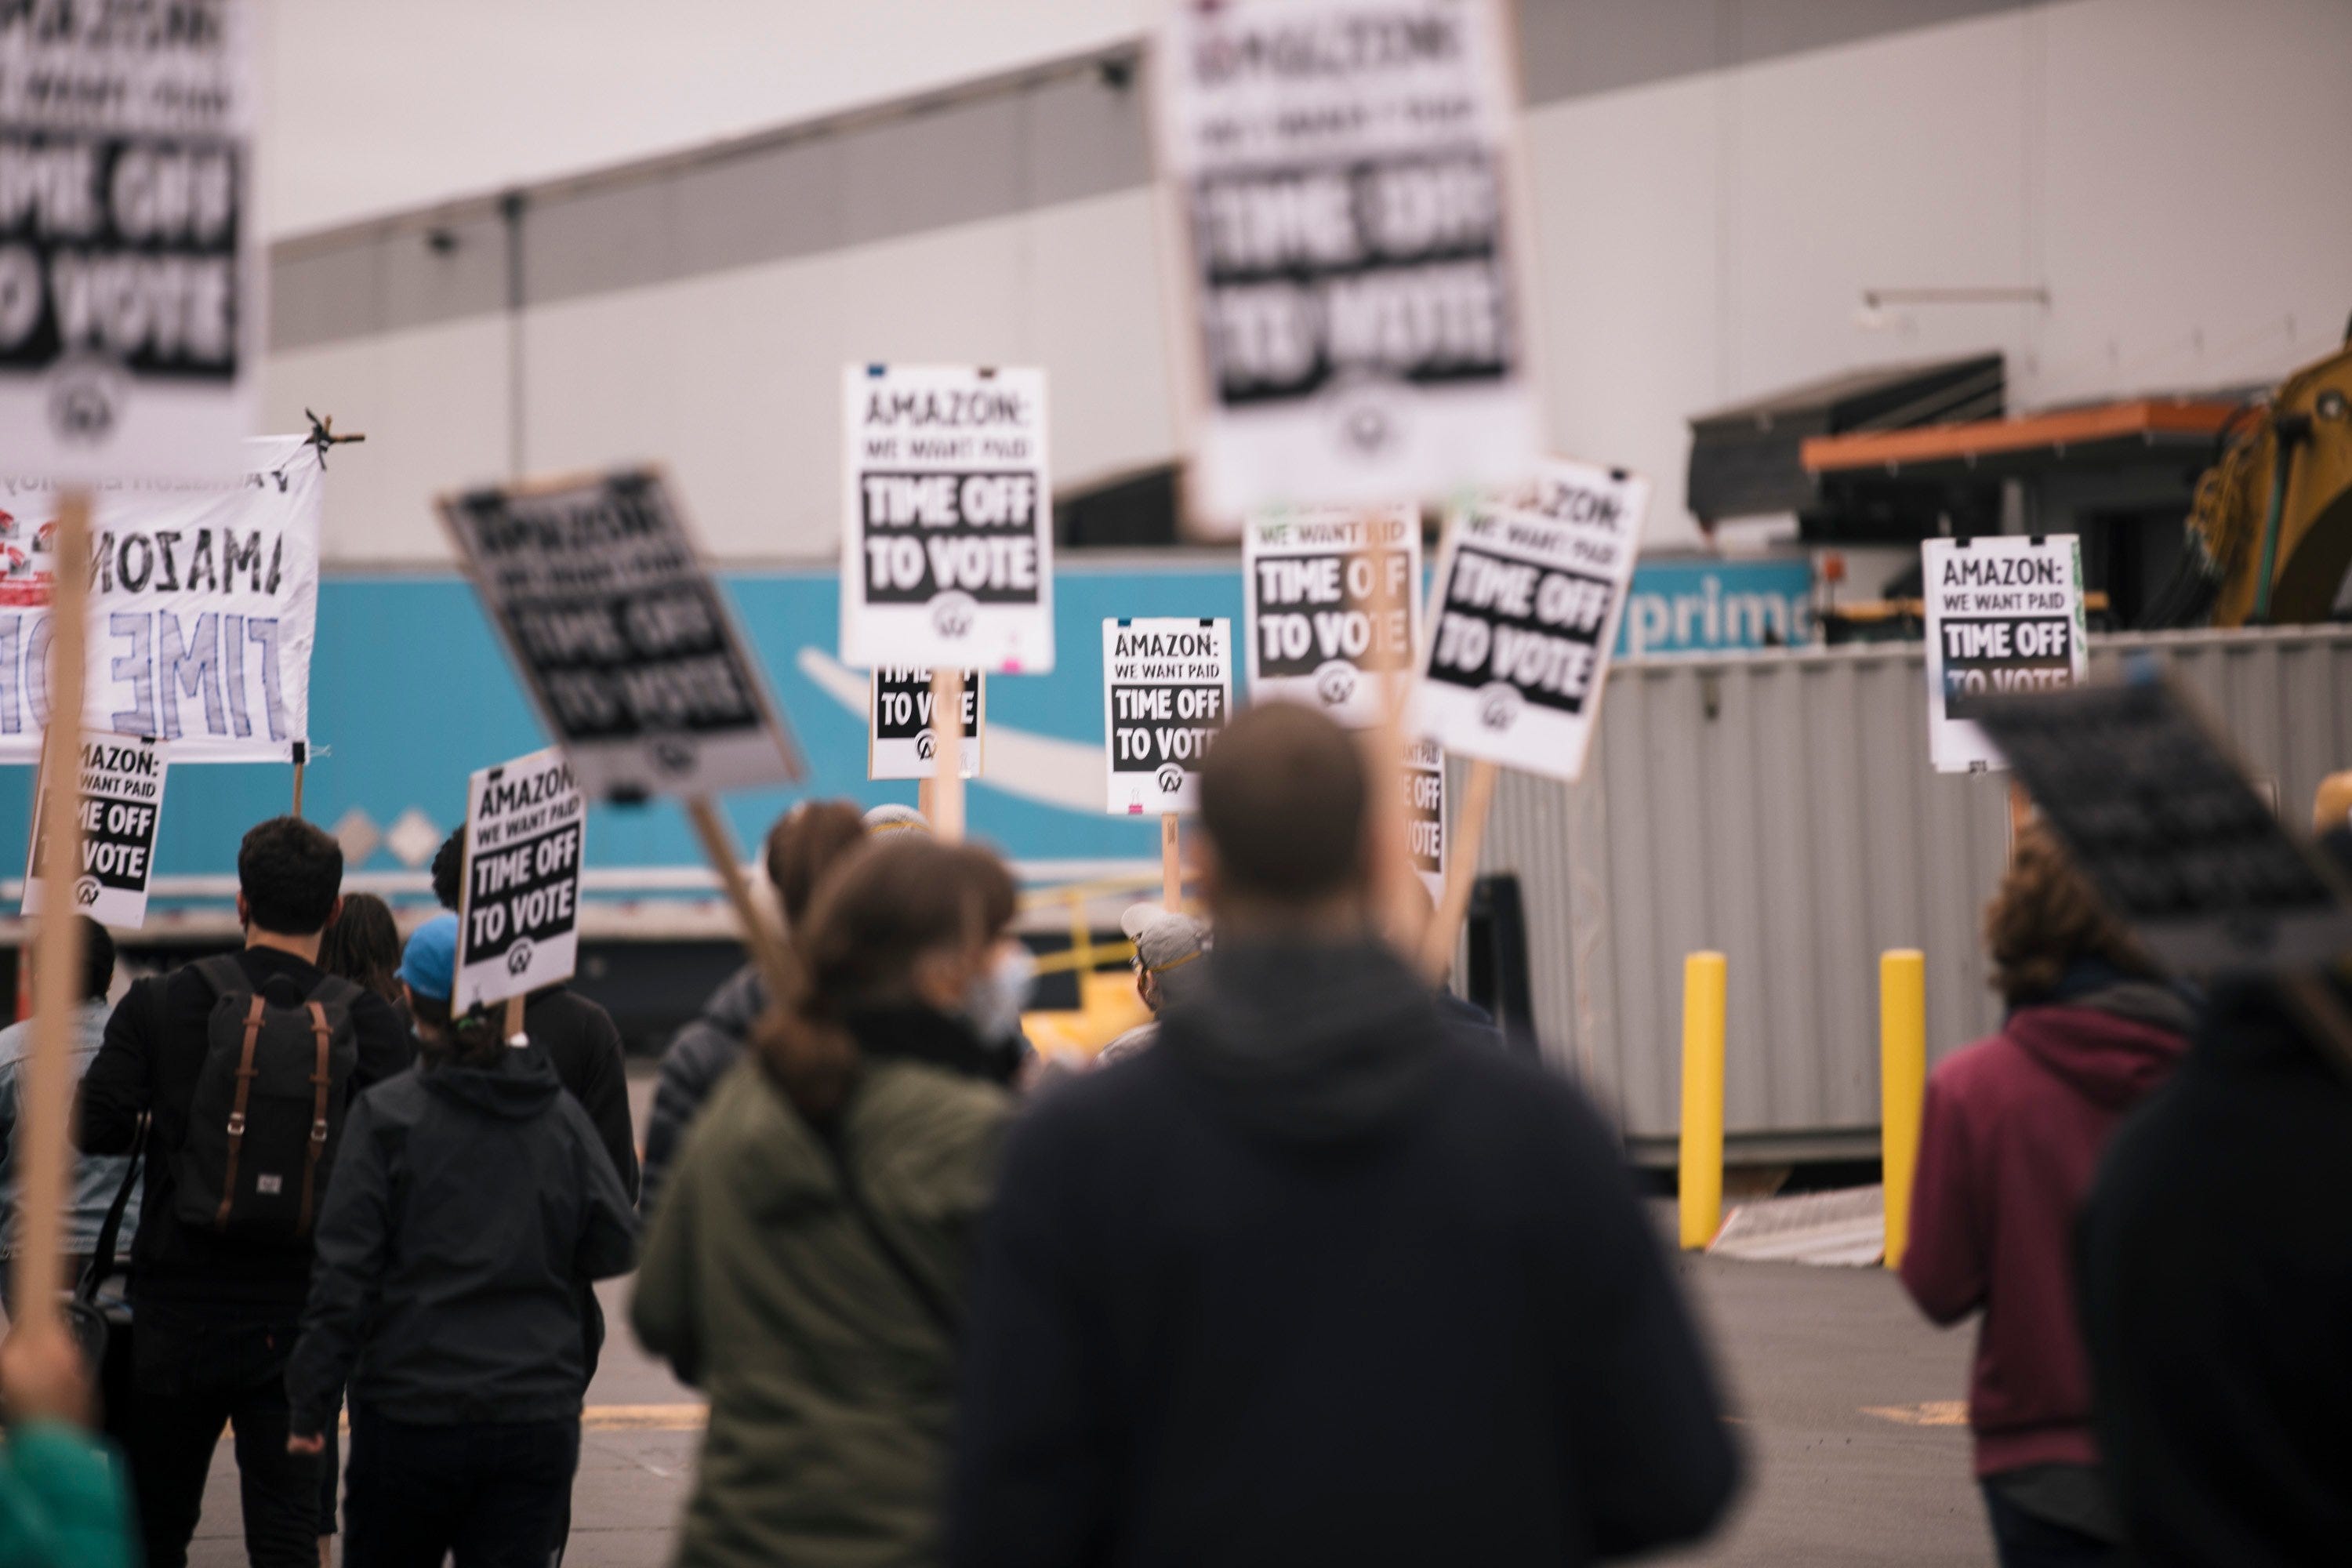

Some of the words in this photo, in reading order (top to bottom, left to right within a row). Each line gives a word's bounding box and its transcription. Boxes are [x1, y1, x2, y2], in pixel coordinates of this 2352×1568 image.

[864, 474, 960, 528] TIME
[960, 474, 1035, 526] OFF
[866, 535, 926, 590] TO
[926, 535, 1036, 590] VOTE
[1258, 557, 1342, 604] TIME
[1347, 555, 1407, 599] OF
[1943, 558, 2063, 586] AMAZON:
[1453, 552, 1541, 617] TIME
[1536, 573, 1608, 633] OFF
[1944, 593, 1969, 612] WE
[1974, 593, 2023, 611] WANT
[2027, 592, 2065, 610] PAID
[1114, 633, 1218, 658] AMAZON:
[1258, 613, 1312, 660] TO
[1435, 612, 1490, 672] TO
[1493, 623, 1595, 698] VOTE
[1944, 622, 2012, 659] TIME
[2016, 622, 2068, 657] OFF
[1115, 664, 1138, 679] WE
[1142, 663, 1185, 679] WANT
[1187, 663, 1220, 679] PAID
[1947, 669, 1987, 695] TO
[880, 691, 913, 726] TO
[916, 690, 975, 726] VE
[1115, 688, 1174, 720] TIME
[1177, 688, 1221, 720] OFF
[1116, 728, 1152, 760] TO
[123, 779, 156, 798] PAID
[478, 761, 577, 821] AMAZON
[1414, 775, 1439, 811] OFF
[107, 803, 152, 837] OFF
[477, 824, 499, 848] WE
[506, 808, 546, 838] WANT
[1406, 819, 1440, 858] OTE
[82, 839, 147, 879] VOTE
[475, 844, 532, 897] TIME
[535, 828, 577, 877] OFF
[472, 902, 506, 947] TO
[511, 877, 574, 935] VOTE
